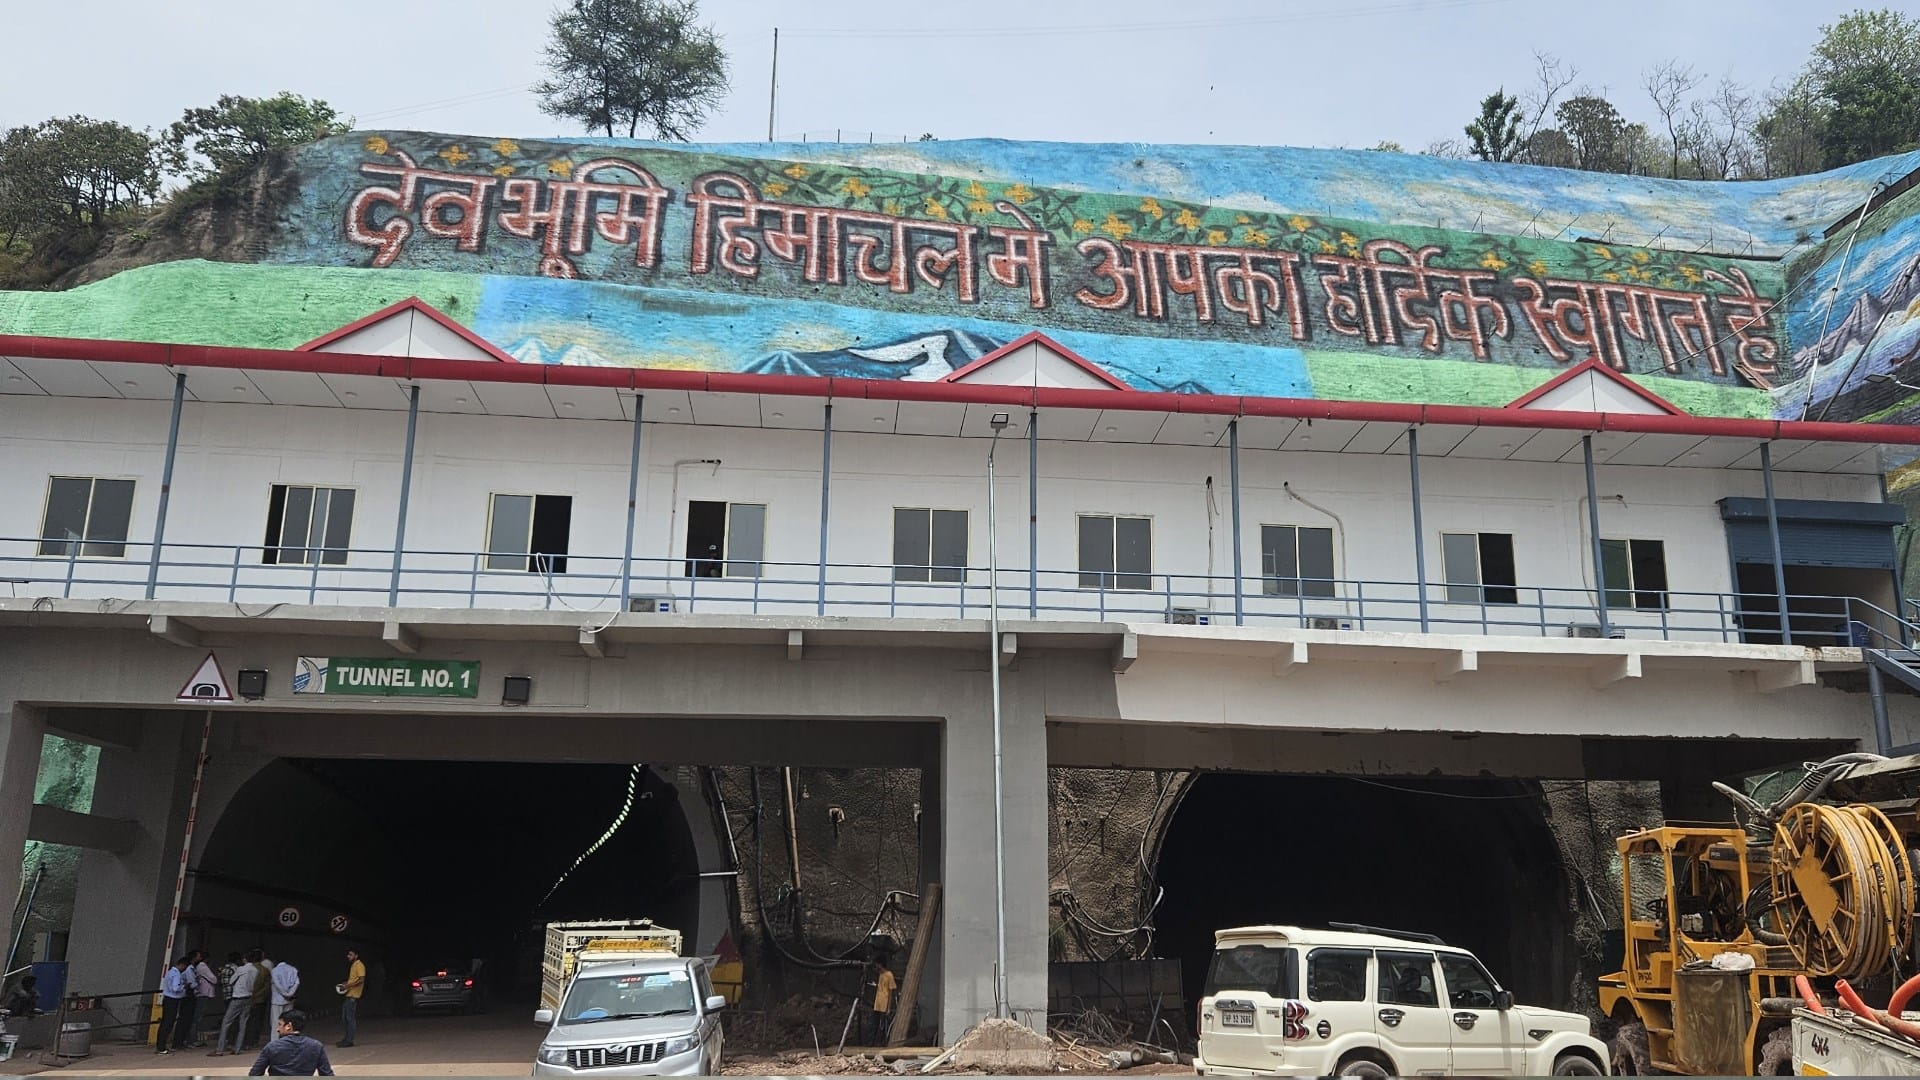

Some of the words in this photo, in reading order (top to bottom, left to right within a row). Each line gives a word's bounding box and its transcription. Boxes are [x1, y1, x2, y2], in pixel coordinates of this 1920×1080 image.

[346, 148, 669, 279] देवभूमि
[685, 170, 979, 303] हिमाचल
[1074, 237, 1306, 340] आपका
[1312, 239, 1510, 362] हार्दिक
[1511, 277, 1728, 376] स्वागत
[1703, 267, 1780, 375] है
[336, 667, 415, 687] TUNNEL
[421, 669, 454, 688] NO.
[460, 670, 470, 688] 1
[281, 912, 297, 922] 60
